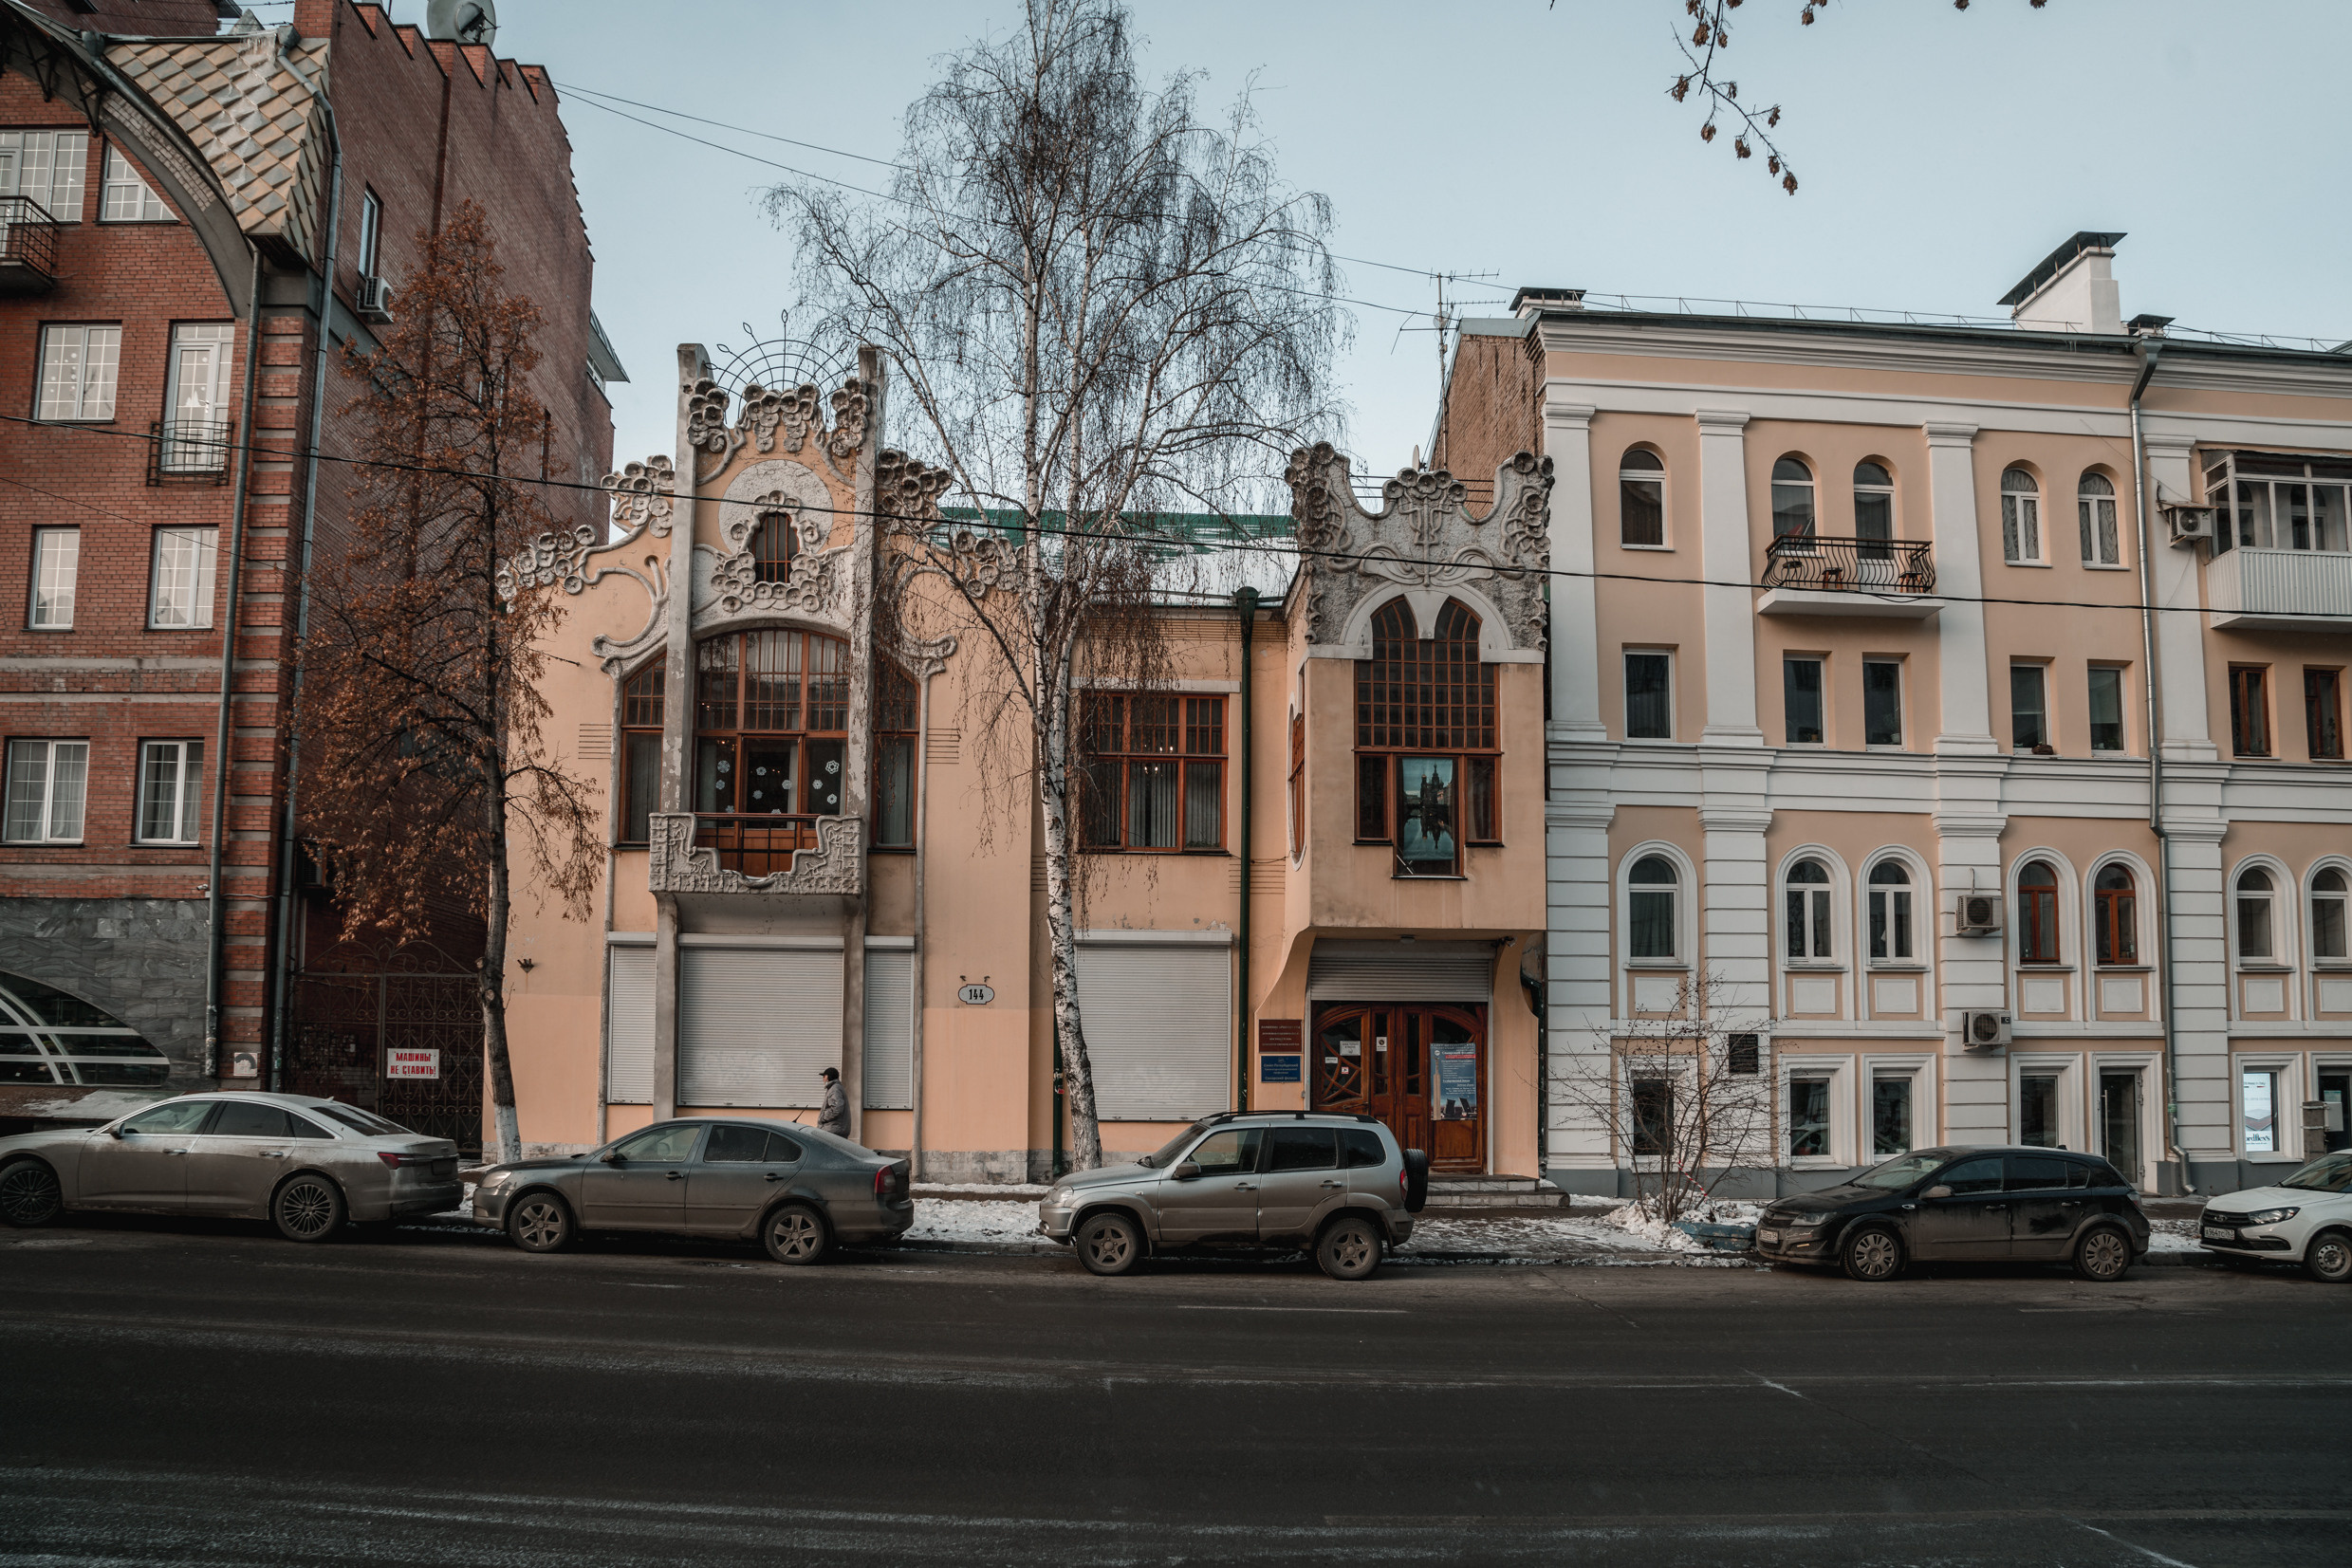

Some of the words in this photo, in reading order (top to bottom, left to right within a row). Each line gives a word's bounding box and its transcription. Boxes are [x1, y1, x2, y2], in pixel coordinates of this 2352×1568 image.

[969, 989, 984, 1000] 144
[396, 1053, 431, 1061] МАШИНЫ
[390, 1065, 399, 1075] НЕ
[402, 1065, 436, 1075] СТАВИТЬ!
